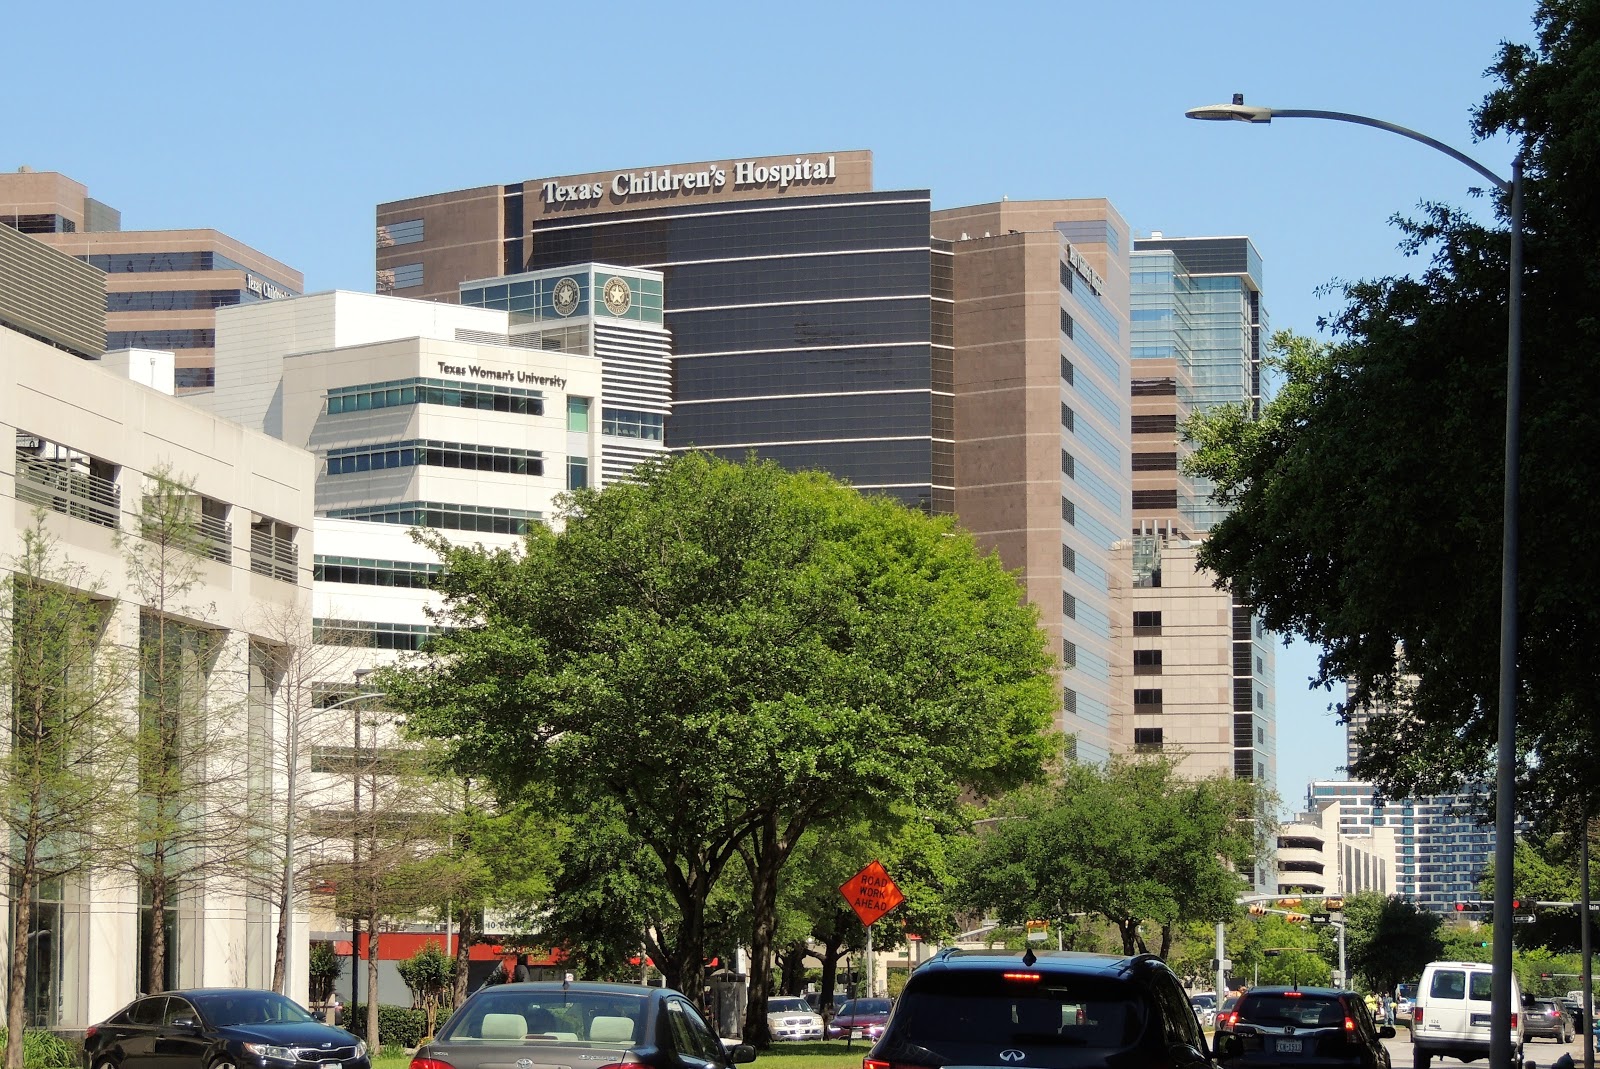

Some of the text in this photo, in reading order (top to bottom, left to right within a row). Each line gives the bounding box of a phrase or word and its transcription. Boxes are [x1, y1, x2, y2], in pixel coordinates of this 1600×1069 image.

[542, 156, 837, 203] Texas Children's Hospital
[437, 361, 568, 391] Texas Woman's University
[861, 875, 888, 888] ROAD
[860, 887, 885, 899] WORK
[854, 898, 887, 911] AHEAD
